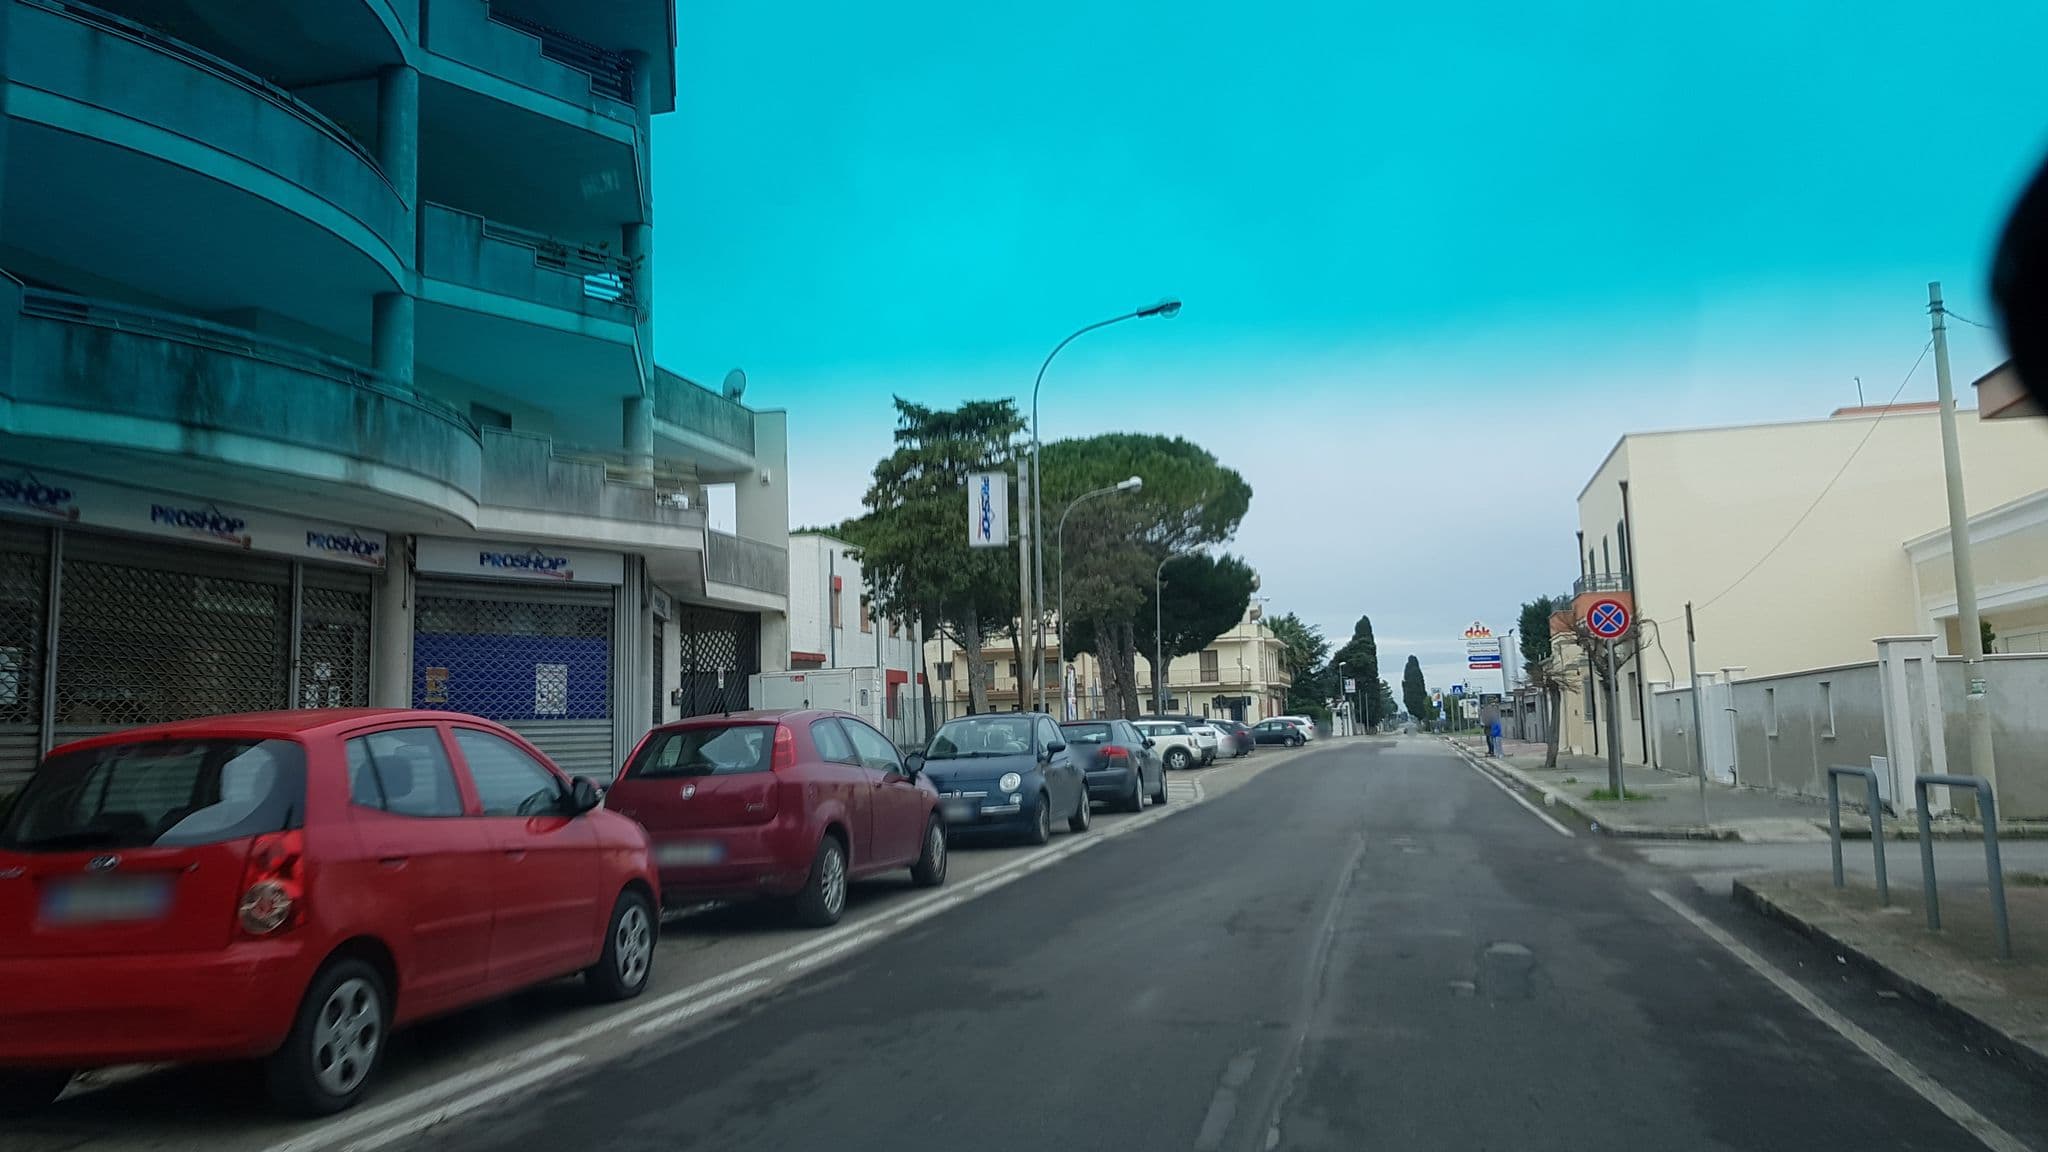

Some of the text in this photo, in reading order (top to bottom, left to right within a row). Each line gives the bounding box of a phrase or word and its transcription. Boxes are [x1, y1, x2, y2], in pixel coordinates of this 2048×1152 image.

[151, 503, 245, 532] PROSHOP
[306, 530, 380, 556] PROSHOP
[480, 551, 567, 570] PROSHOP
